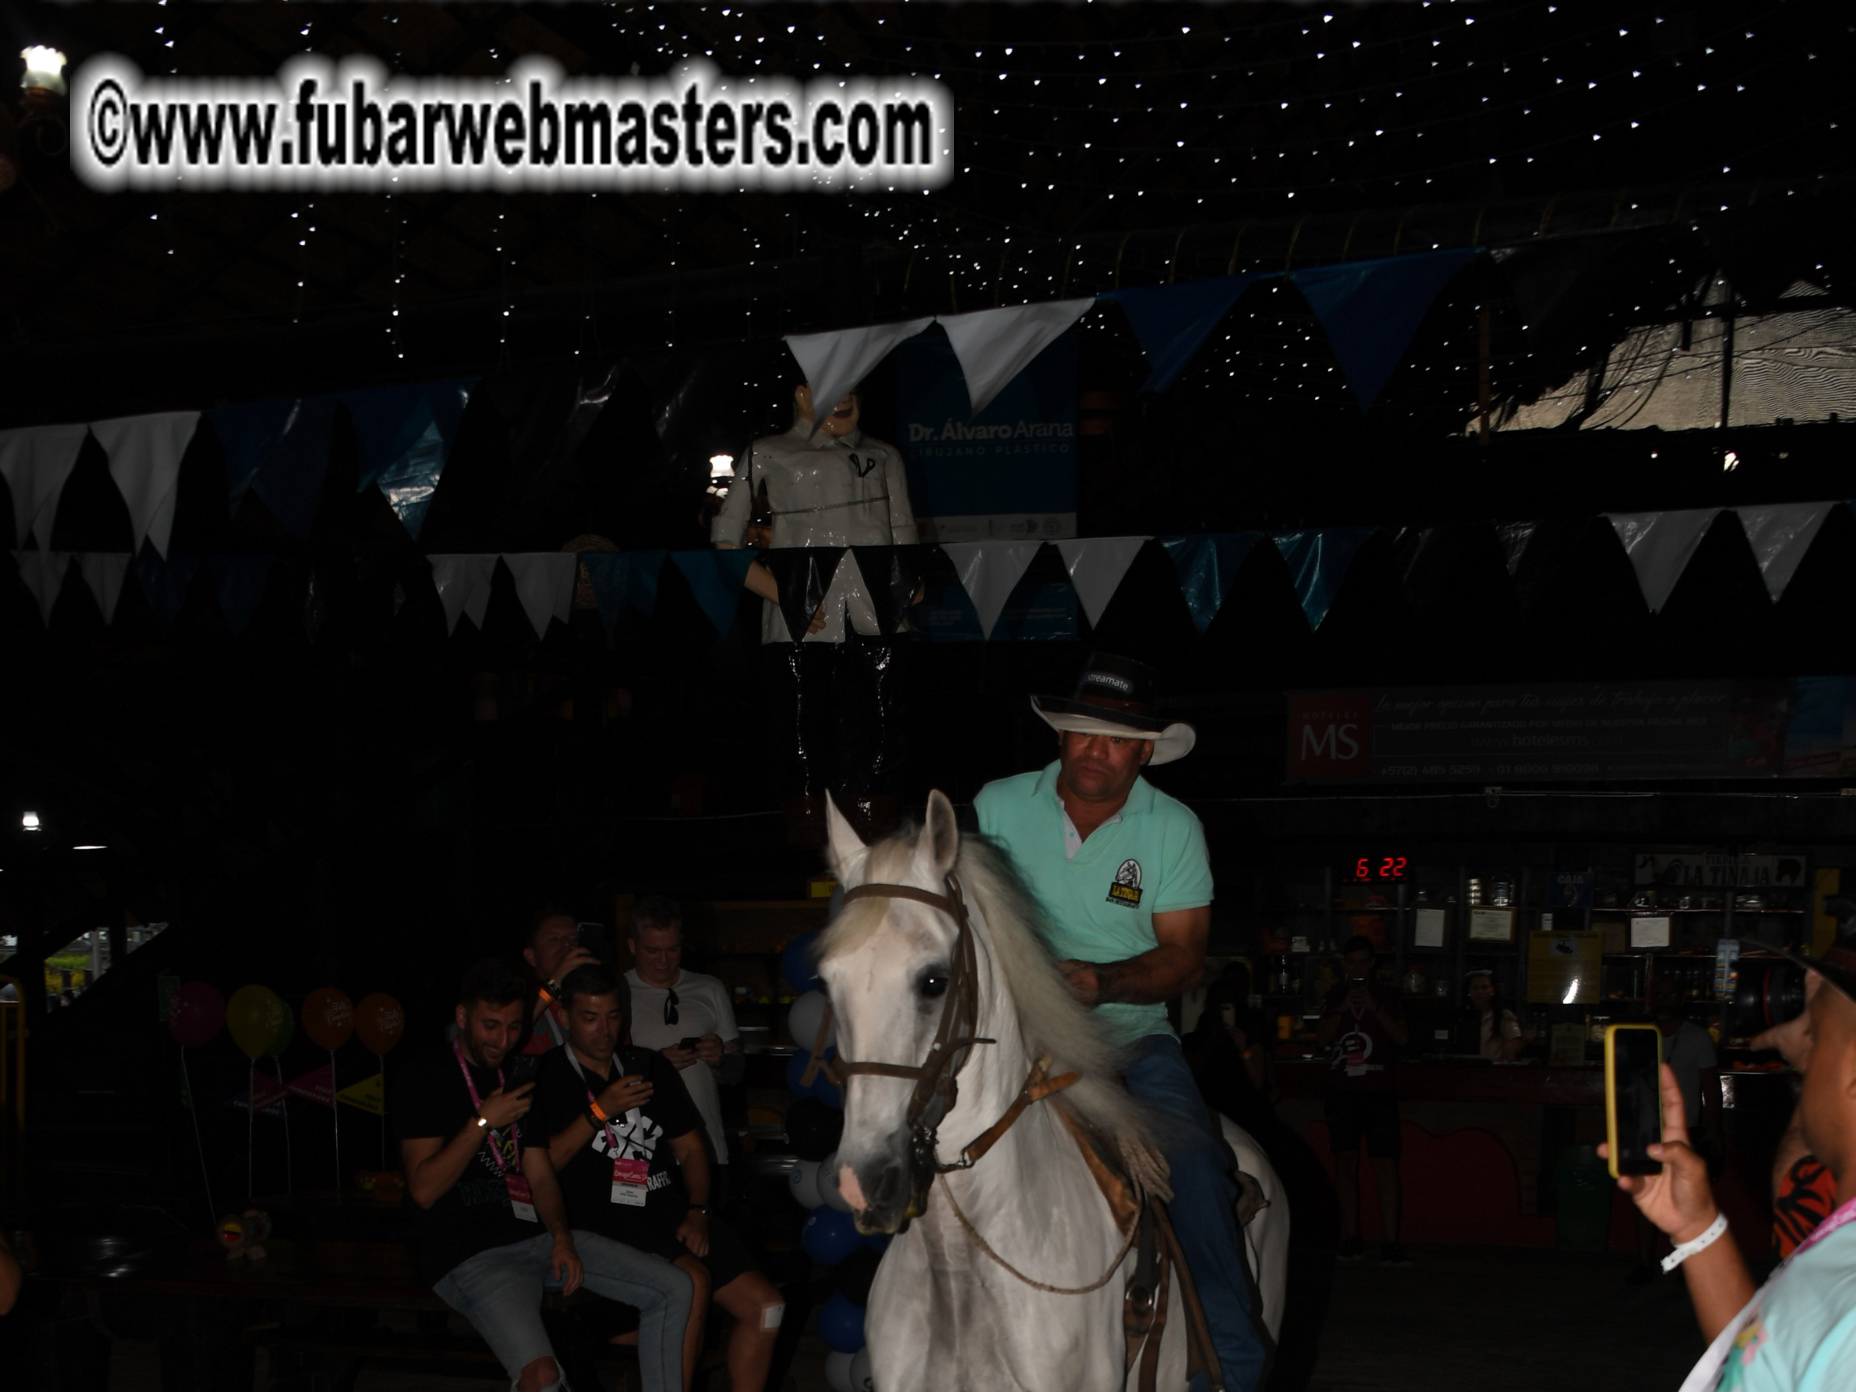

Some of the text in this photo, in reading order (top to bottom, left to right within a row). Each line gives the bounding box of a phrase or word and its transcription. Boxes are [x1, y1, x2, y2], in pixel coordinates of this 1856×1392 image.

[908, 416, 1075, 442] Dr. Álvaro Arana
[1302, 711, 1358, 721] HOTELES
[1391, 721, 1422, 731] MEJOR
[1424, 720, 1459, 730] PRECIO
[1460, 719, 1527, 730] GARANTIZADO
[1528, 719, 1550, 729] POR
[1551, 718, 1584, 729] MEDIO
[1585, 718, 1599, 728] DE
[1600, 717, 1645, 728] NUESTRA
[1684, 716, 1707, 726] WEB
[1300, 722, 1360, 762] MS
[1422, 764, 1446, 775] 485
[1449, 763, 1482, 775] 5259
[1496, 762, 1600, 775] 01 8000 910098
[1355, 856, 1408, 878] 6 22
[1556, 873, 1585, 885] CAJA
[1683, 865, 1770, 886] LA TINAJA
